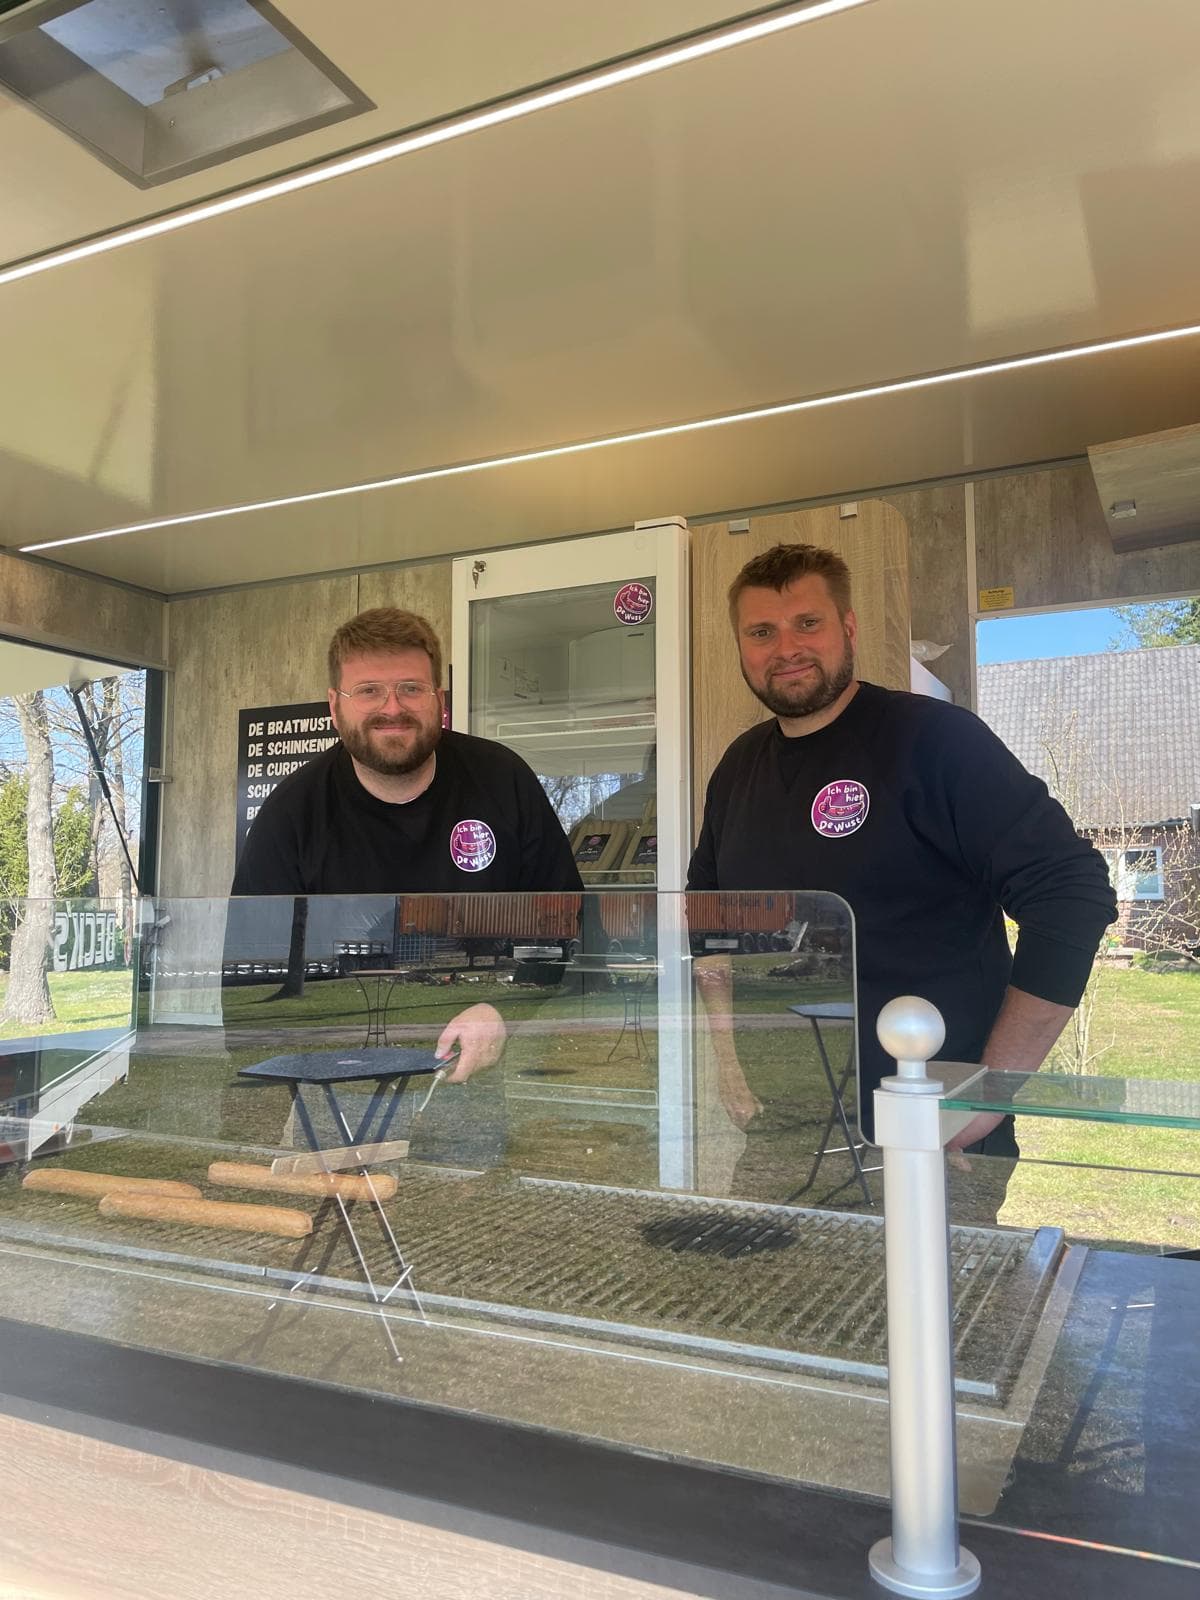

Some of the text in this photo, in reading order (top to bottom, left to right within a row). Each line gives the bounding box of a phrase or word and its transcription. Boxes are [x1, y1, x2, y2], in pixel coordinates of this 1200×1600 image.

[248, 716, 333, 737] DE BRATWUST
[247, 743, 263, 758] DE
[247, 763, 263, 778] DE
[827, 784, 858, 795] Ich bin
[845, 793, 865, 803] hier
[457, 824, 483, 833] Ich bin
[819, 816, 861, 833] De Wust
[456, 855, 469, 864] De
